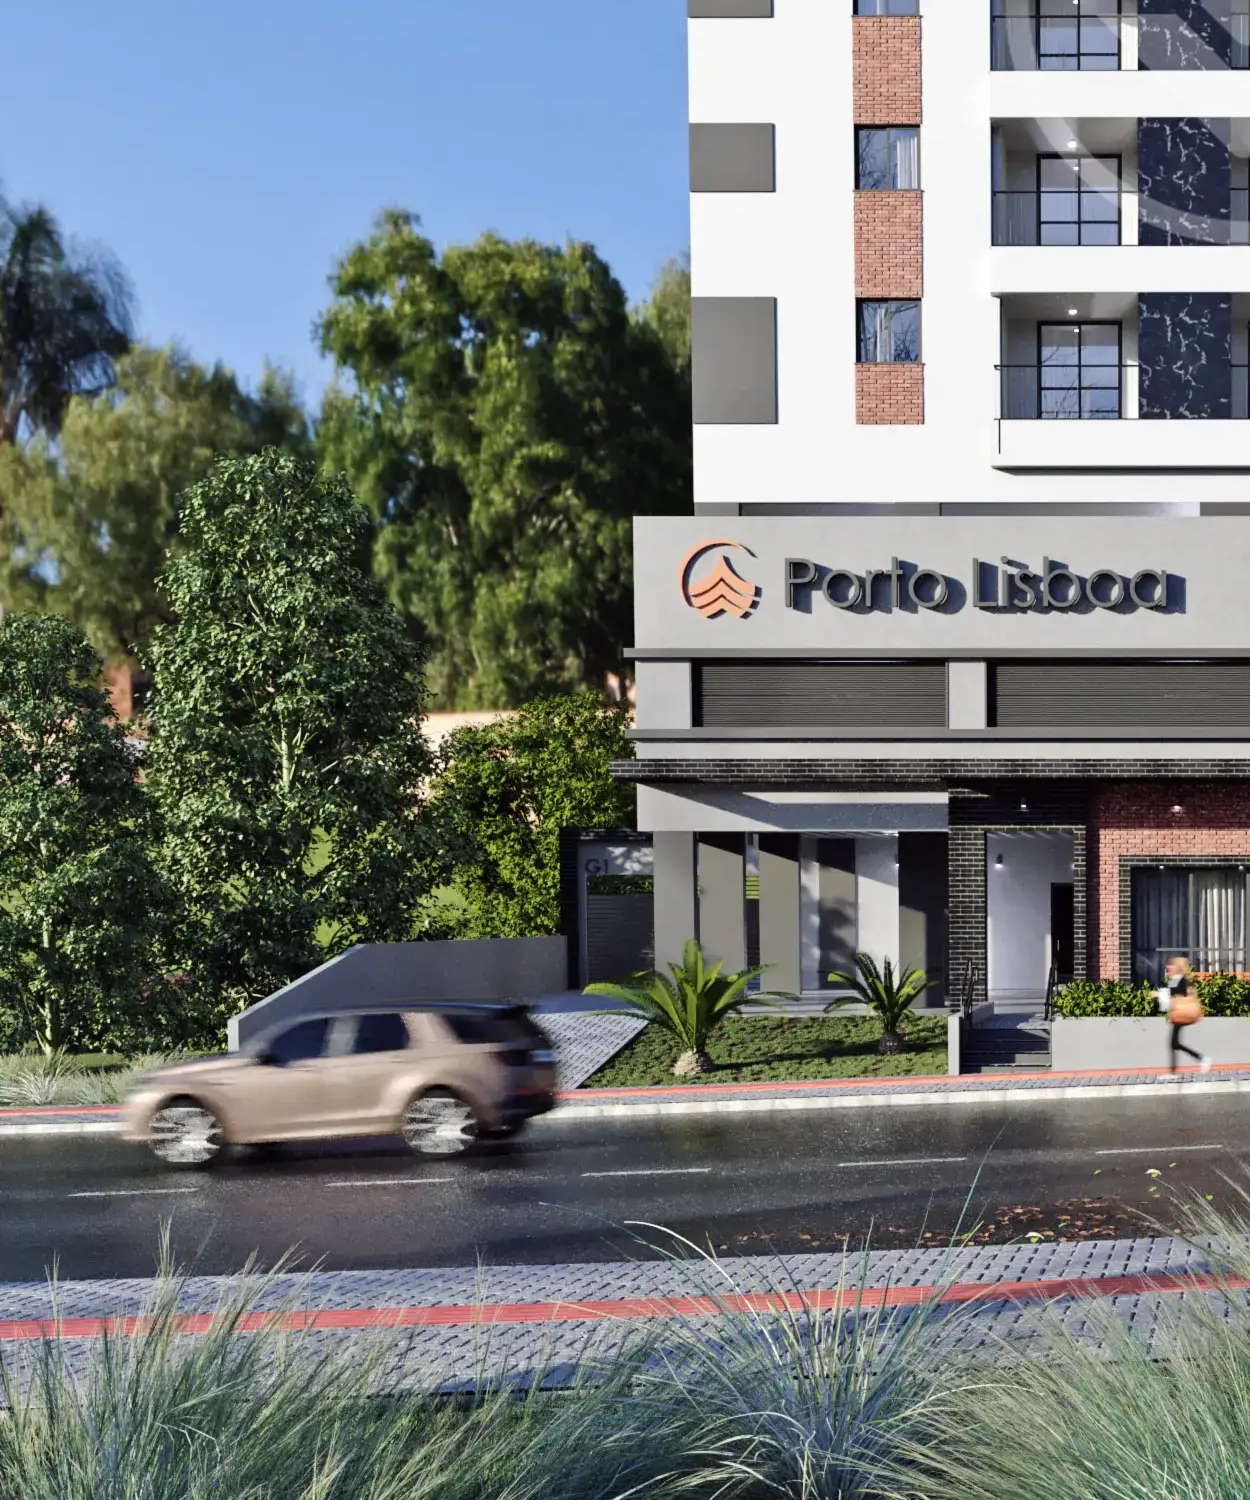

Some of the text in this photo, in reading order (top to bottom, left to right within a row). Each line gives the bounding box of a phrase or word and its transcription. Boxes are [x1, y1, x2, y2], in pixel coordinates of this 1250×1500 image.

[784, 555, 1168, 609] Porto Lisboa
[584, 858, 609, 874] G1
